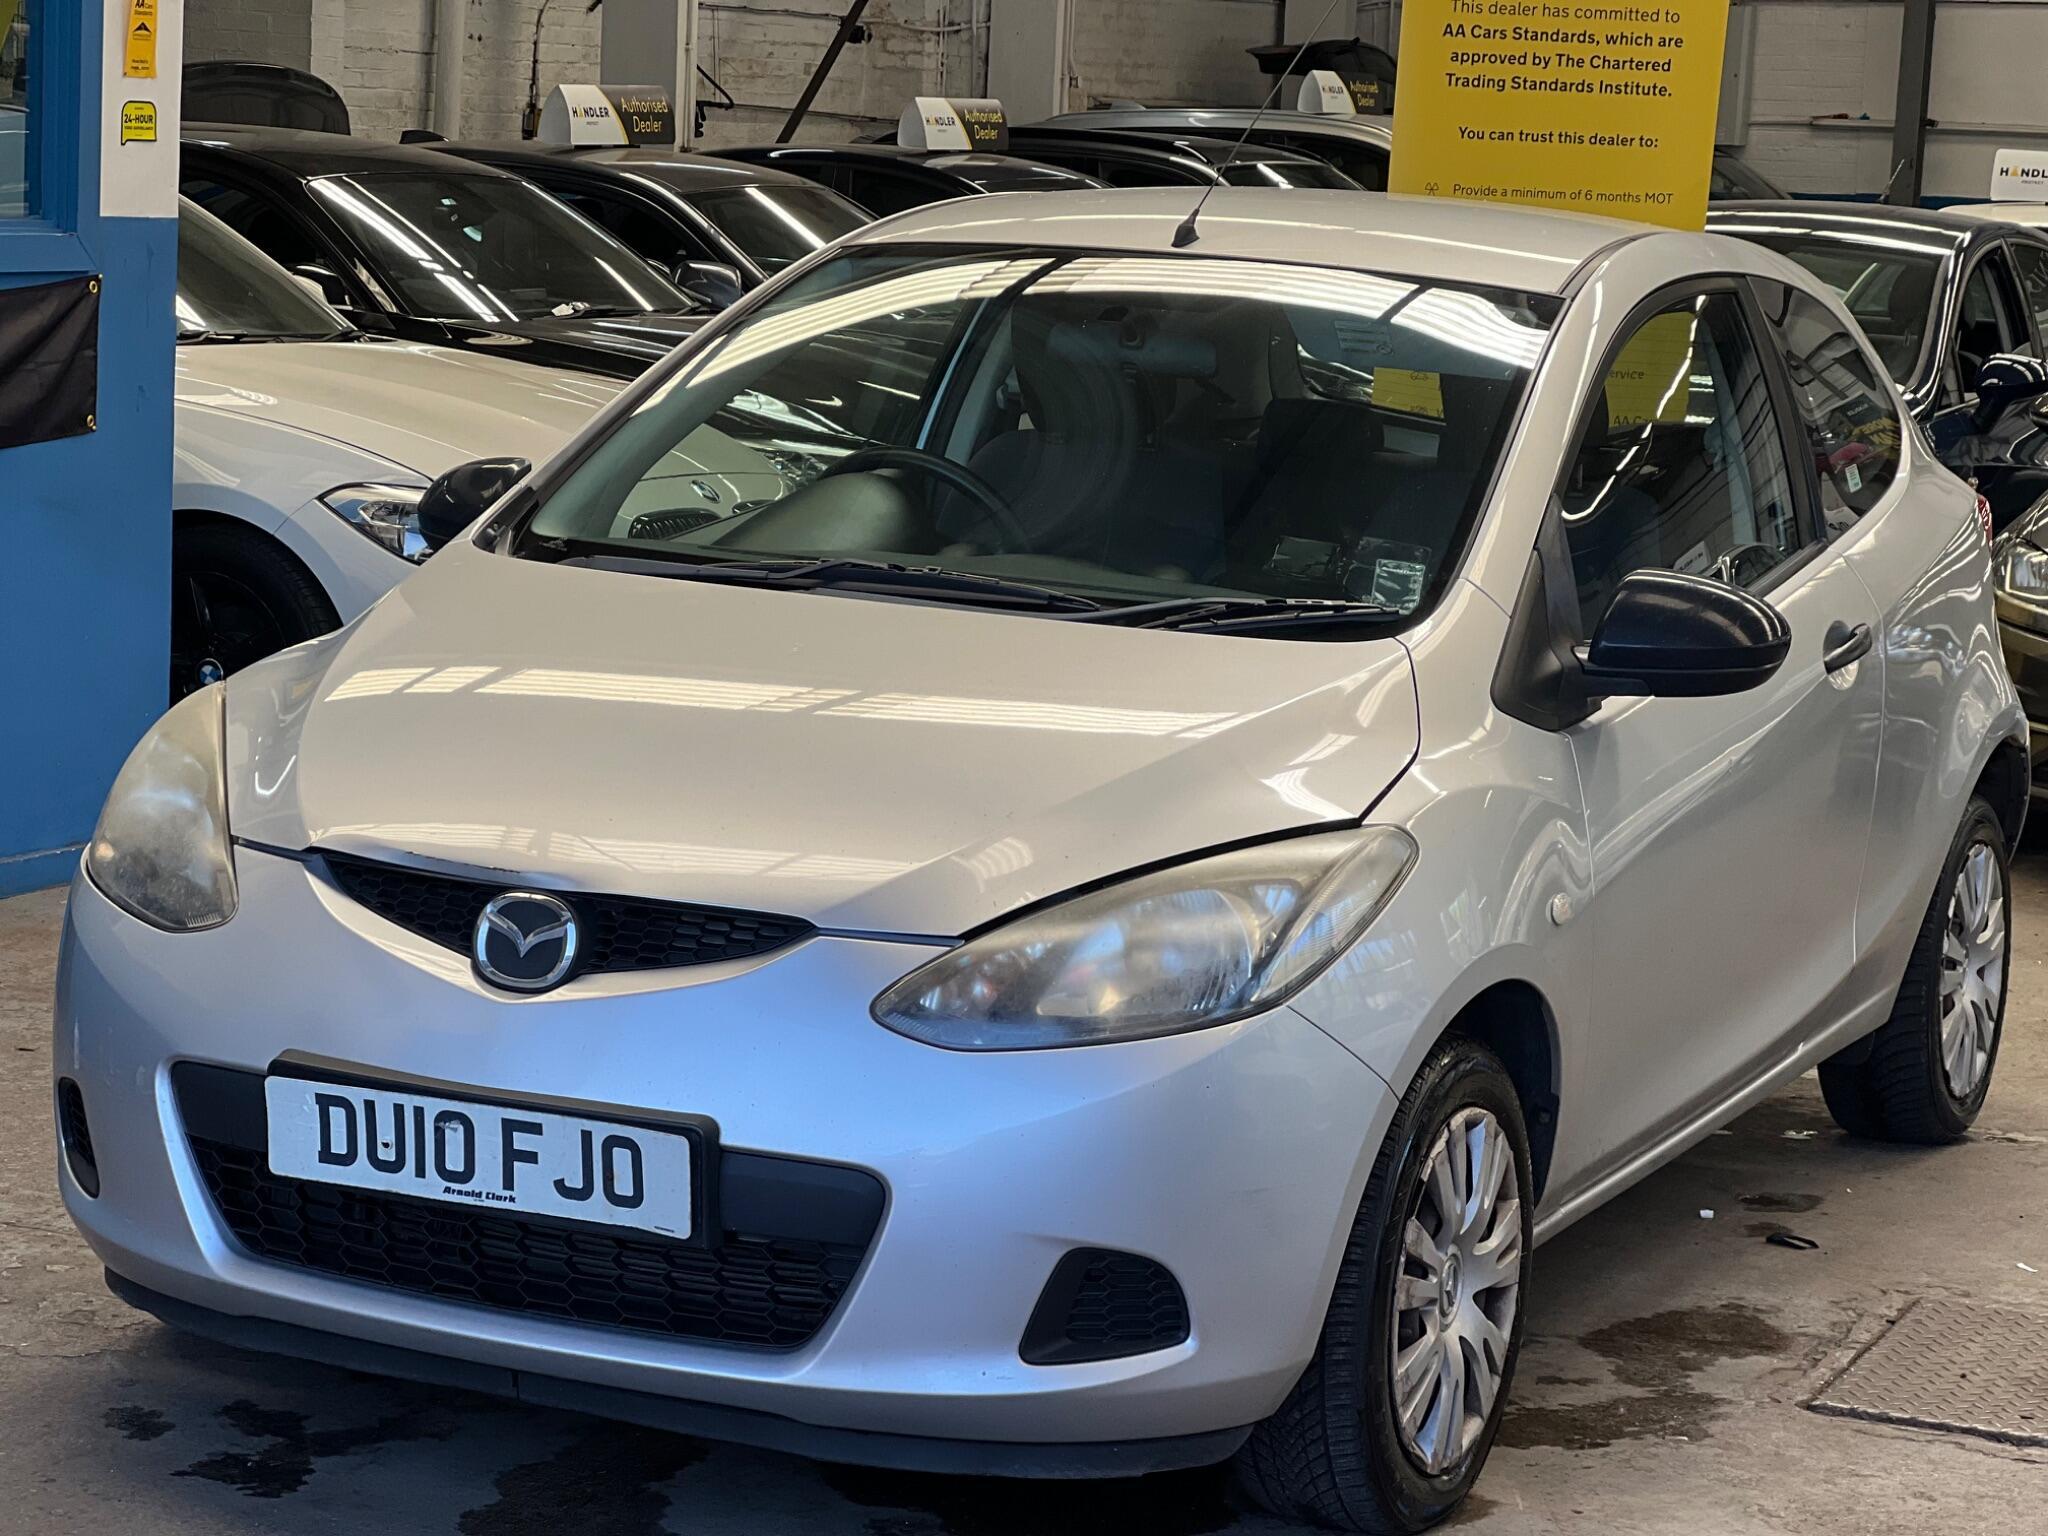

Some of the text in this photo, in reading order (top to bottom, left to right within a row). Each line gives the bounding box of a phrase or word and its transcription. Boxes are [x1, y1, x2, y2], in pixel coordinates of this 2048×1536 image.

[1451, 0, 1681, 23] This dealer has committed to
[1443, 23, 1684, 48] AA Cars Standards, which are
[1450, 51, 1672, 72] approved by The Chartered
[1446, 73, 1672, 97] Trading Standards Institute.
[621, 96, 669, 113] Authorised
[124, 114, 154, 124] 24-HOUR
[632, 115, 663, 133] Dealer
[963, 108, 1003, 123] Authorised
[973, 124, 999, 140] Dealer
[1459, 126, 1659, 149] You can trust this dealer to:
[1453, 184, 1675, 205] Provide a minimum of 6 months MOT
[443, 1186, 517, 1204] Arnold Clark
